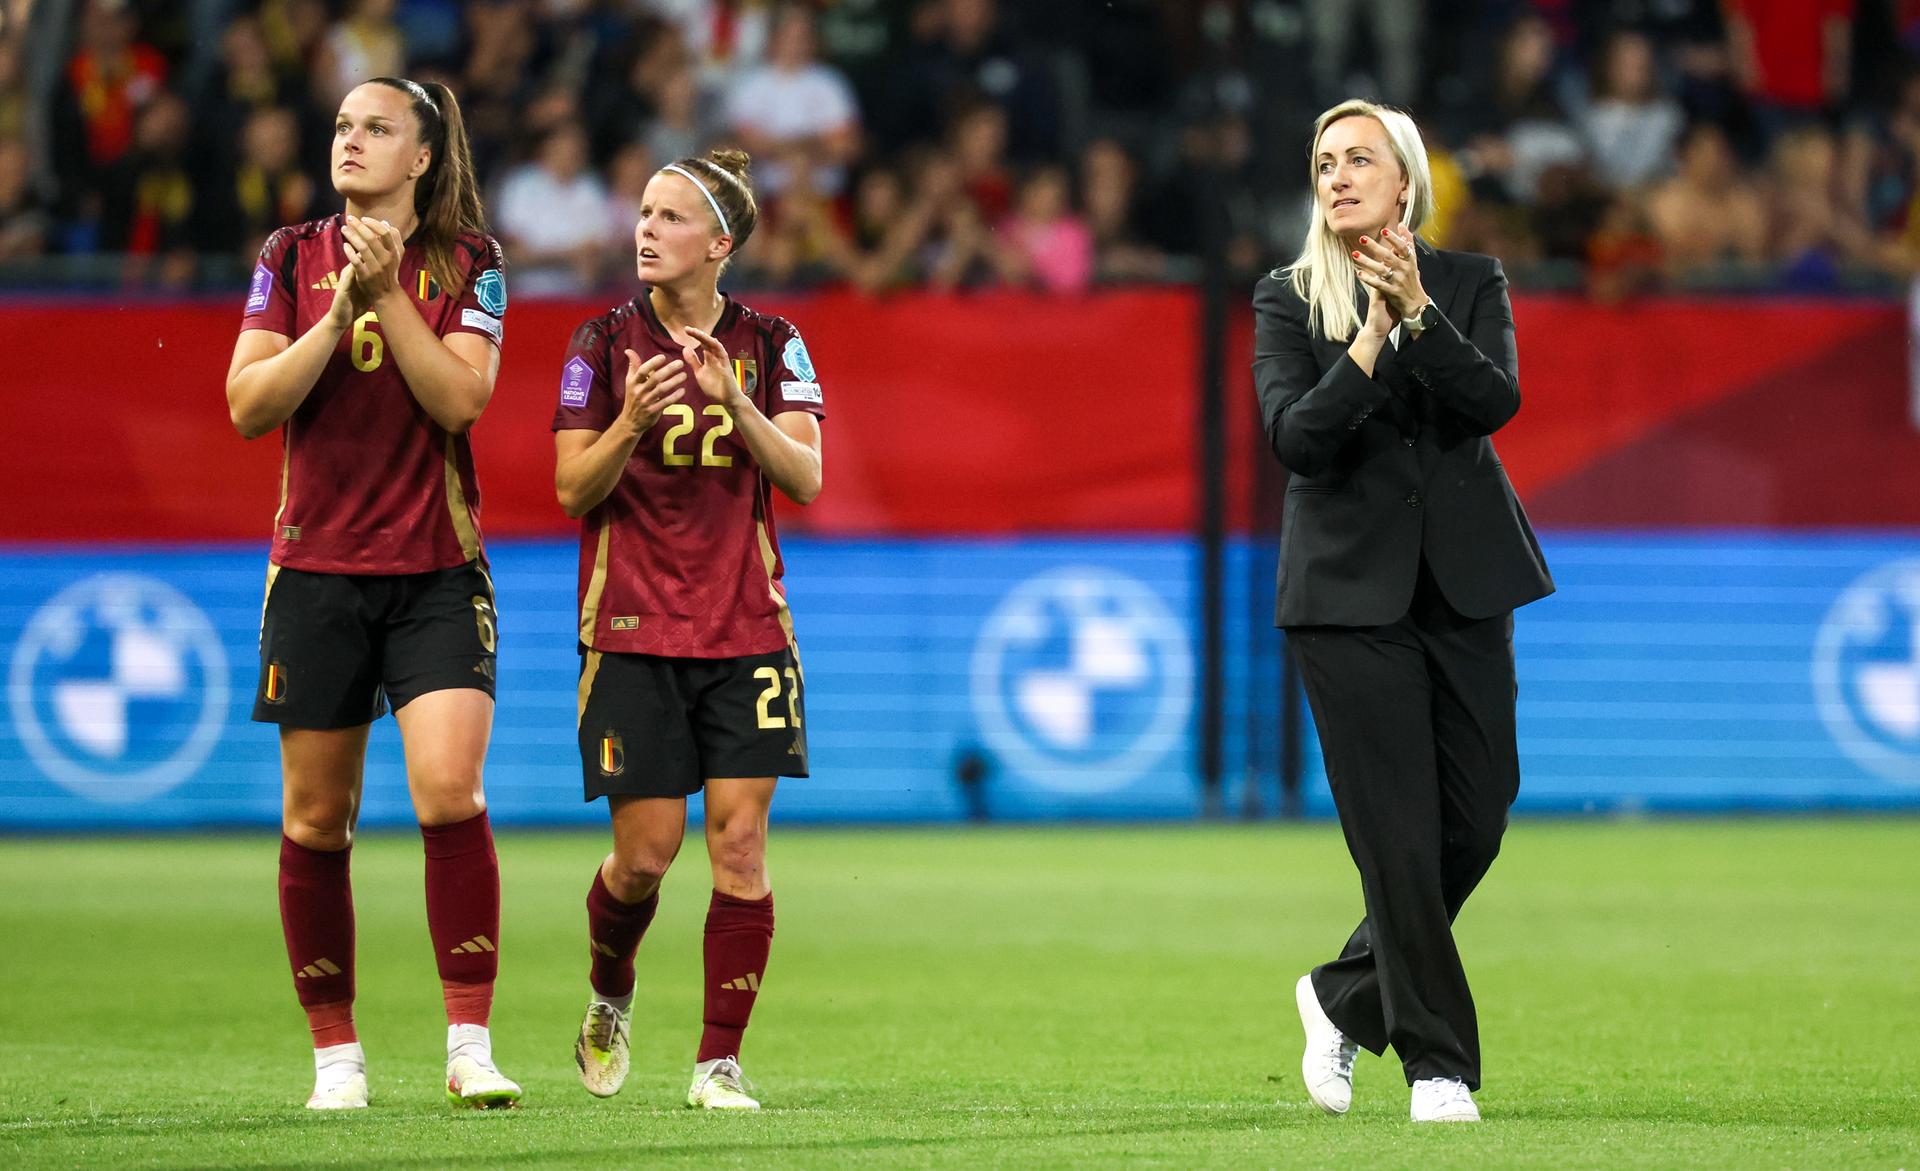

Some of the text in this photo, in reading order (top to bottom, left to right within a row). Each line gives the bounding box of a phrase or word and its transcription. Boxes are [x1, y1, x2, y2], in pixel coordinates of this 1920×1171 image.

[352, 312, 383, 372] 6
[662, 404, 733, 467] 22
[472, 595, 495, 653] 6
[753, 667, 801, 729] 22
